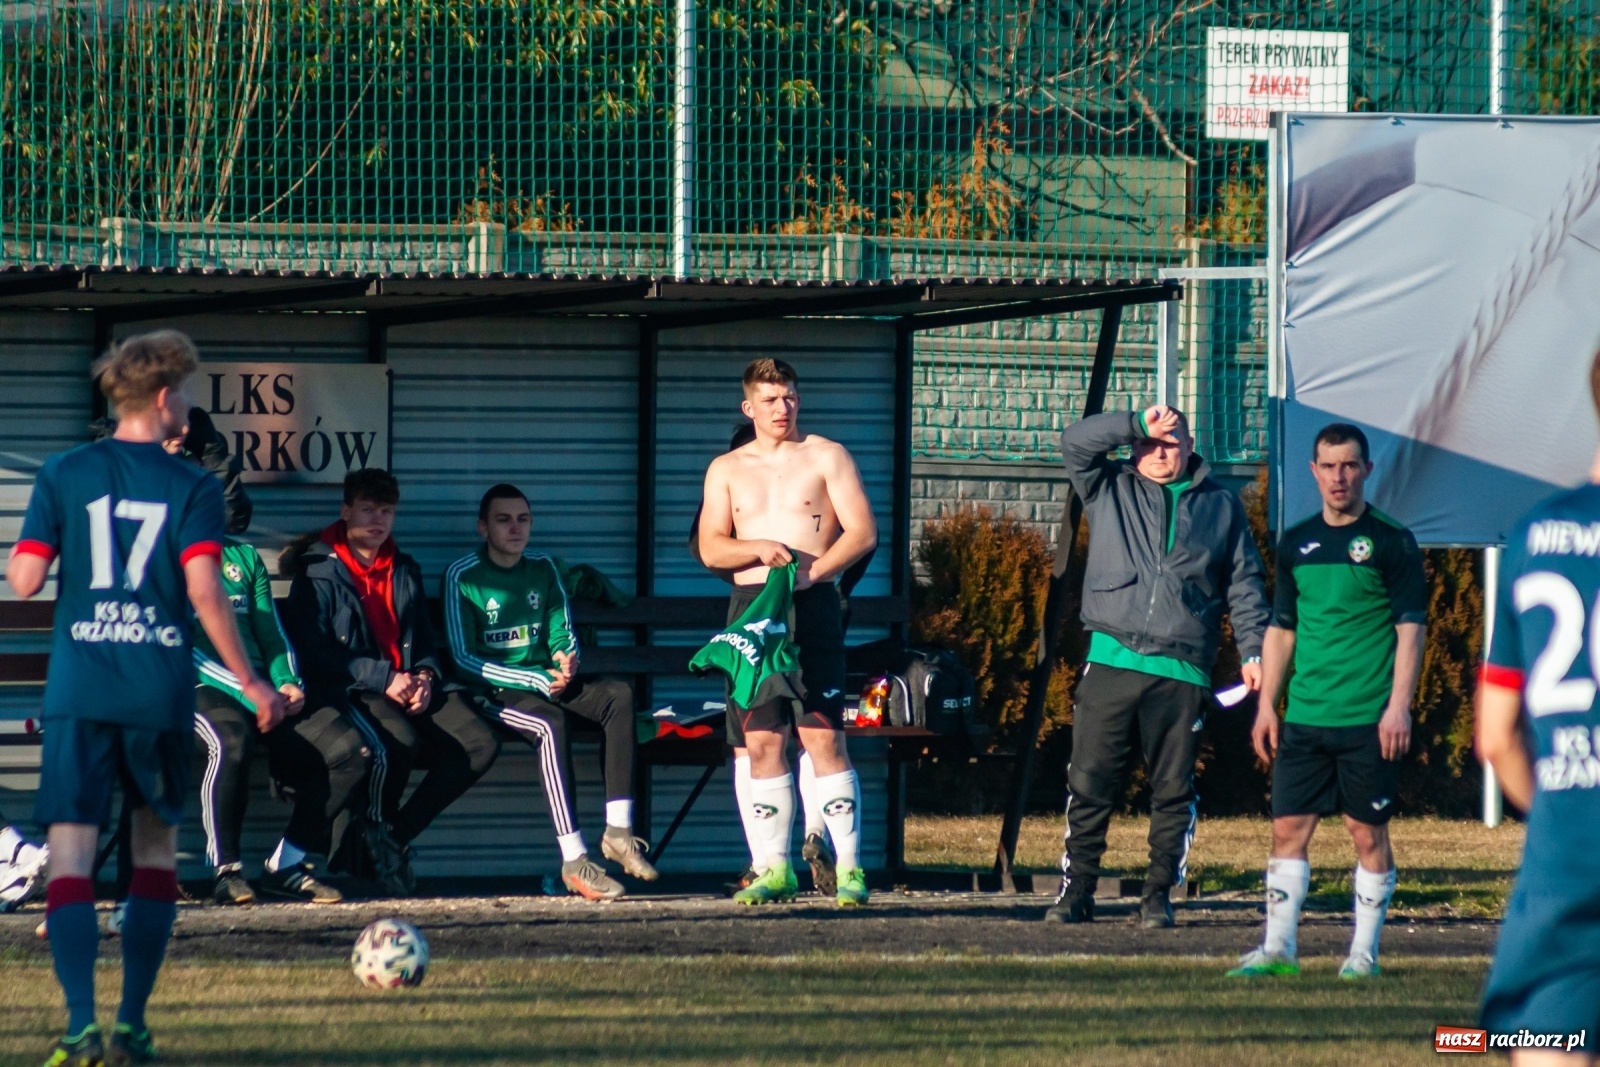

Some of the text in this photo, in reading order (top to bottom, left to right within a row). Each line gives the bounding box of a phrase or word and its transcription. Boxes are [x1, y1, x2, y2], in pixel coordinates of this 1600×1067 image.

[1218, 41, 1339, 67] TEREN PRYWATNY
[1249, 74, 1310, 96] ZAKAZ!
[1217, 106, 1275, 129] PRZERZU
[207, 373, 295, 415] LKS
[812, 514, 822, 533] 7
[85, 494, 168, 591] 17
[94, 601, 156, 625] KS 195
[1513, 571, 1600, 718] 2
